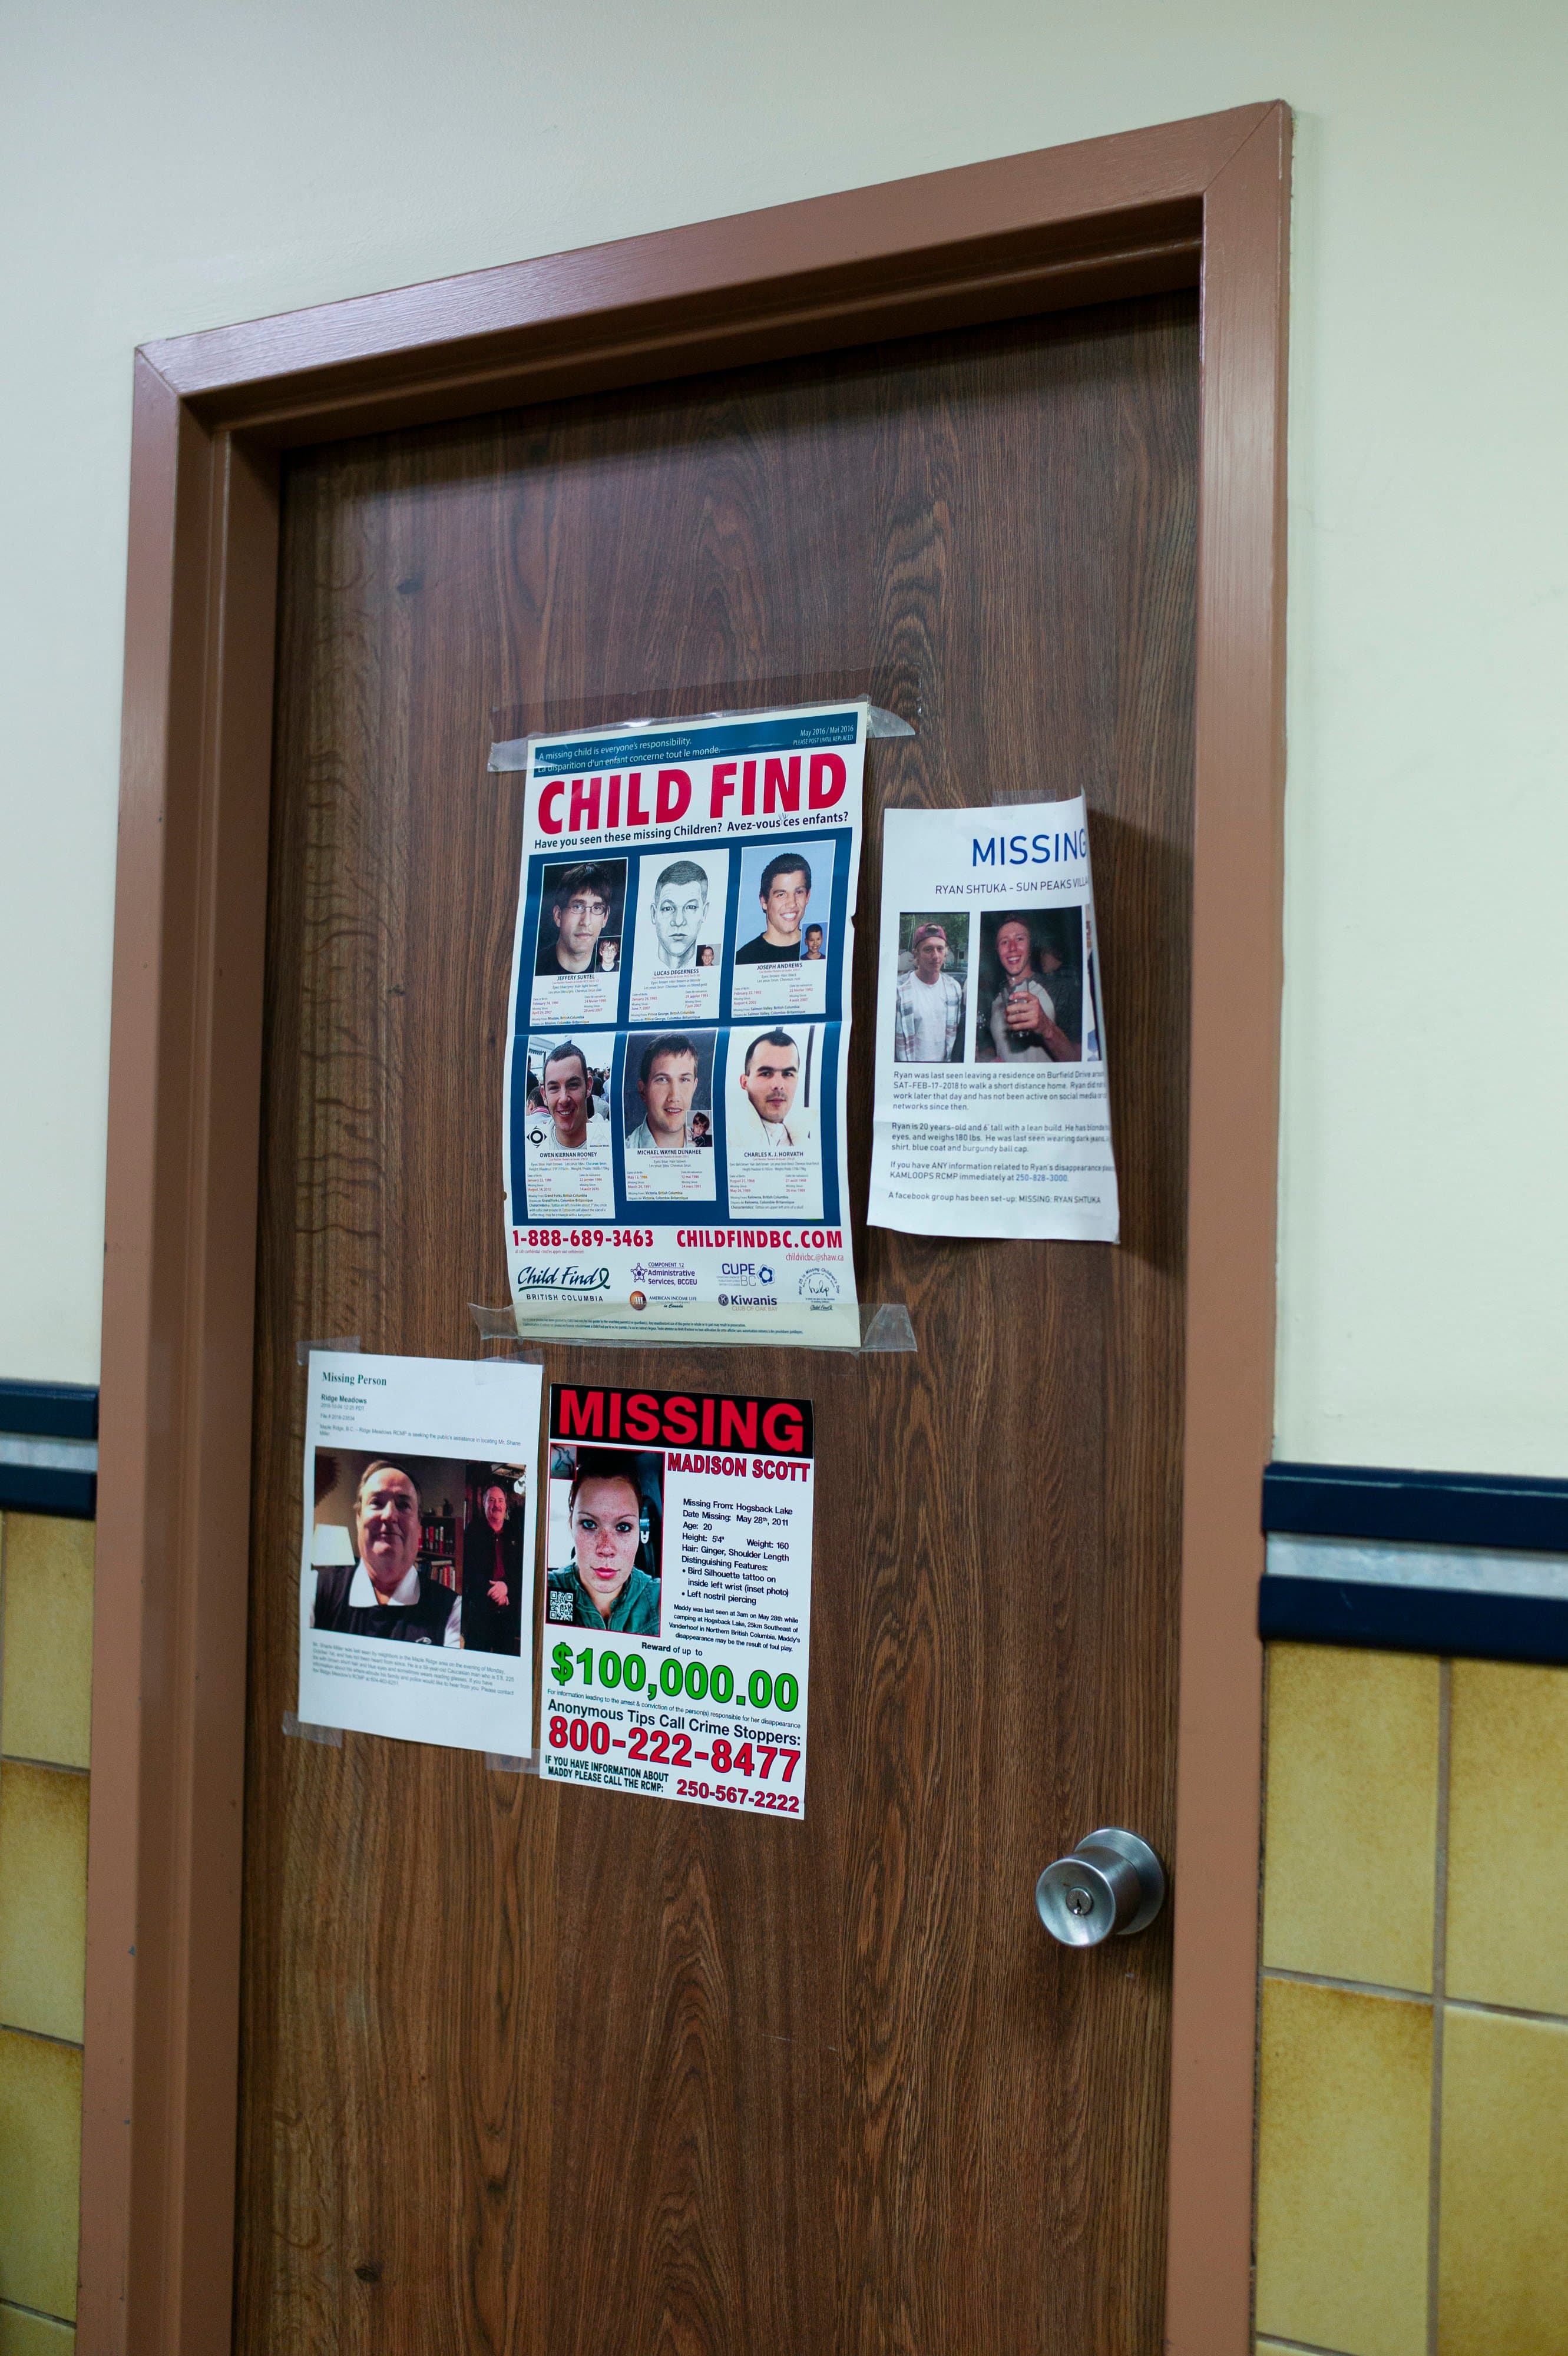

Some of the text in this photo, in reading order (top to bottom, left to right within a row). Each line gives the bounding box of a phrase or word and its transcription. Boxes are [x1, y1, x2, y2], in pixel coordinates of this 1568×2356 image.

[800, 729, 811, 737] May
[546, 750, 573, 759] missing
[574, 747, 592, 756] child
[601, 742, 637, 754] everyone's
[640, 737, 692, 749] responsibility.
[547, 762, 585, 772] disparition
[587, 759, 603, 767] d'un
[605, 756, 627, 766] enfant
[629, 753, 664, 762] concerne
[692, 746, 720, 755] monde.
[538, 753, 846, 834] CHILD FIND
[534, 811, 848, 849] Have you seen these missing Children? Avez-vous ces enfants?
[972, 828, 1087, 867] MISSING
[935, 885, 963, 894] RYAN
[966, 884, 1006, 894] SHTUKA
[1016, 882, 1037, 891] SUN
[1040, 879, 1072, 889] PEAKS
[959, 1174, 1005, 1182] immediately
[512, 1229, 653, 1246] 1-888-689-3463
[677, 1230, 842, 1249] CHILDFINDBC.COM
[786, 1253, 843, 1262] childvicbc.@shaw.ca
[517, 1266, 600, 1285] Child Find
[722, 1263, 755, 1275] CUPE
[740, 1275, 756, 1286] BC
[809, 1279, 829, 1296] help
[731, 1295, 778, 1305] Kiwanis
[322, 1371, 386, 1385] Missing Person
[321, 1394, 366, 1404] Ridge Meadows
[559, 1390, 803, 1452] MISSING
[668, 1452, 811, 1482] MADISON SCOTT
[683, 1498, 793, 1515] Missing From: Hogsback Lake
[683, 1510, 788, 1526] Date Missing: May 28th, 2011
[683, 1521, 698, 1530] Age:
[682, 1533, 725, 1543] Height: 5'4"
[746, 1538, 789, 1550] Weight: 160
[682, 1544, 789, 1562] Hair: Ginger, Shoulder Length
[682, 1555, 768, 1571] Distinguishing Features:
[687, 1567, 702, 1575] Bird
[704, 1569, 740, 1579] Silhouette
[742, 1573, 765, 1581] tattoo
[687, 1590, 756, 1606] Left nostril piercing
[641, 1642, 671, 1652] Reward
[551, 1642, 799, 1712] $100,000.00
[548, 1699, 800, 1746] Anonymous Tips Call Crime Stoppers:
[549, 1716, 800, 1782] 800-222-8477
[545, 1755, 669, 1782] IF YOU HAVE INFORMATION ABOUT
[548, 1766, 664, 1792] MADDY PLEASE CALL THE RCMP:
[677, 1779, 799, 1813] 250-567-2222
